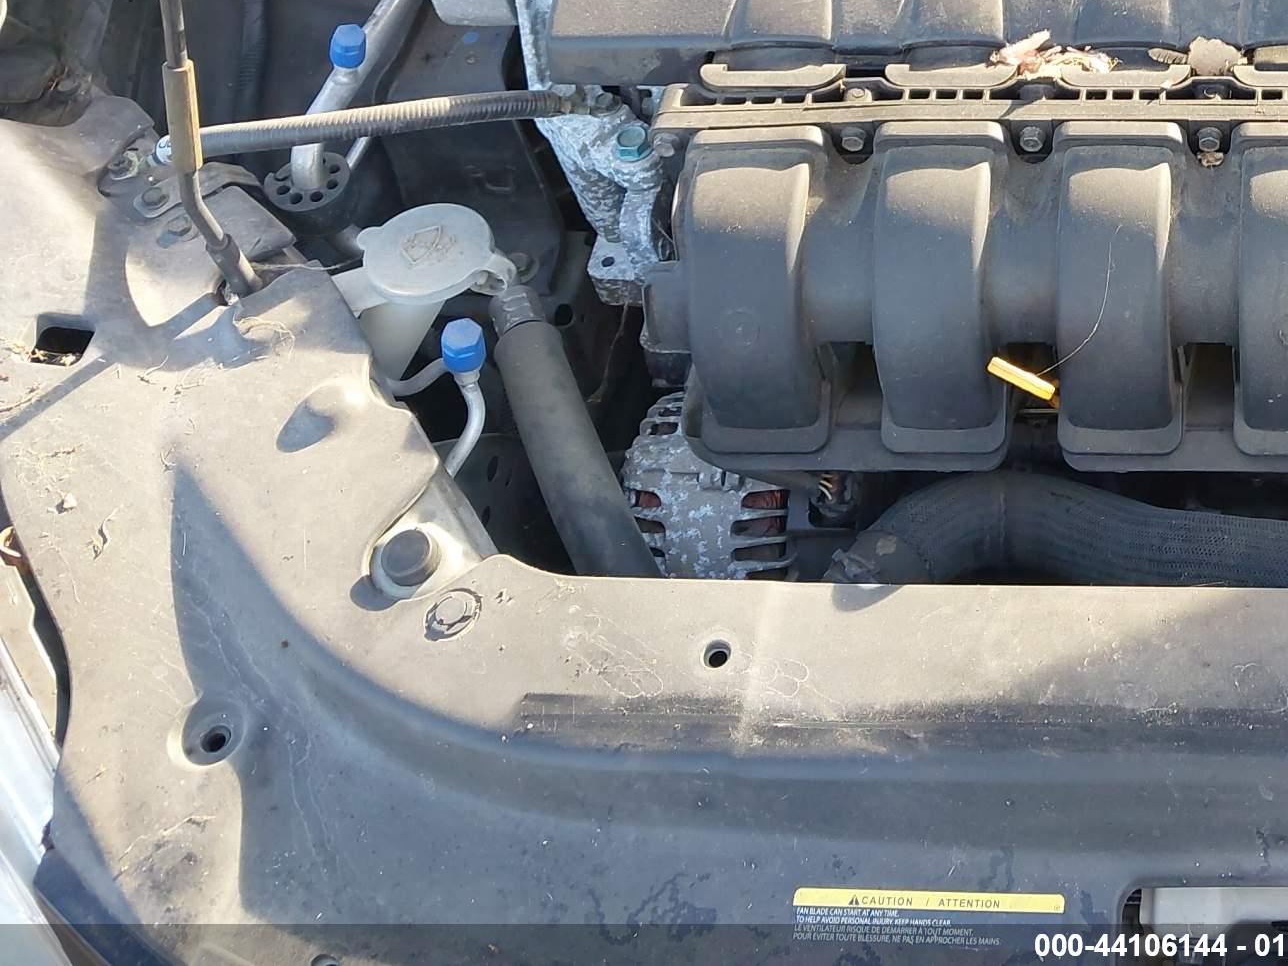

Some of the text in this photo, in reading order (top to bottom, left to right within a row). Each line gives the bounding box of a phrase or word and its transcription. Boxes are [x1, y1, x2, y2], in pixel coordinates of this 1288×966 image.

[861, 896, 913, 906] CAUTION
[938, 898, 1001, 909] ATTENTION
[796, 907, 809, 915] FAN
[809, 907, 829, 916] BLADE
[830, 908, 843, 916] CAN
[843, 908, 861, 916] START
[870, 909, 884, 917] ANY
[796, 915, 806, 923] TO
[806, 916, 821, 924] HELP
[820, 916, 840, 924] AVOID
[840, 917, 871, 925] PERSONAL
[893, 918, 910, 926] KEEP
[794, 924, 803, 932] LE
[803, 924, 846, 932] VENTILATEUR
[846, 925, 871, 934] RISQUE
[872, 925, 881, 933] DE
[923, 927, 940, 935] TOUT
[857, 934, 891, 943] BLESSURE,
[892, 935, 902, 943] NE
[902, 936, 914, 944] PAS
[915, 936, 925, 944] EN
[925, 937, 965, 945] APPROCHER
